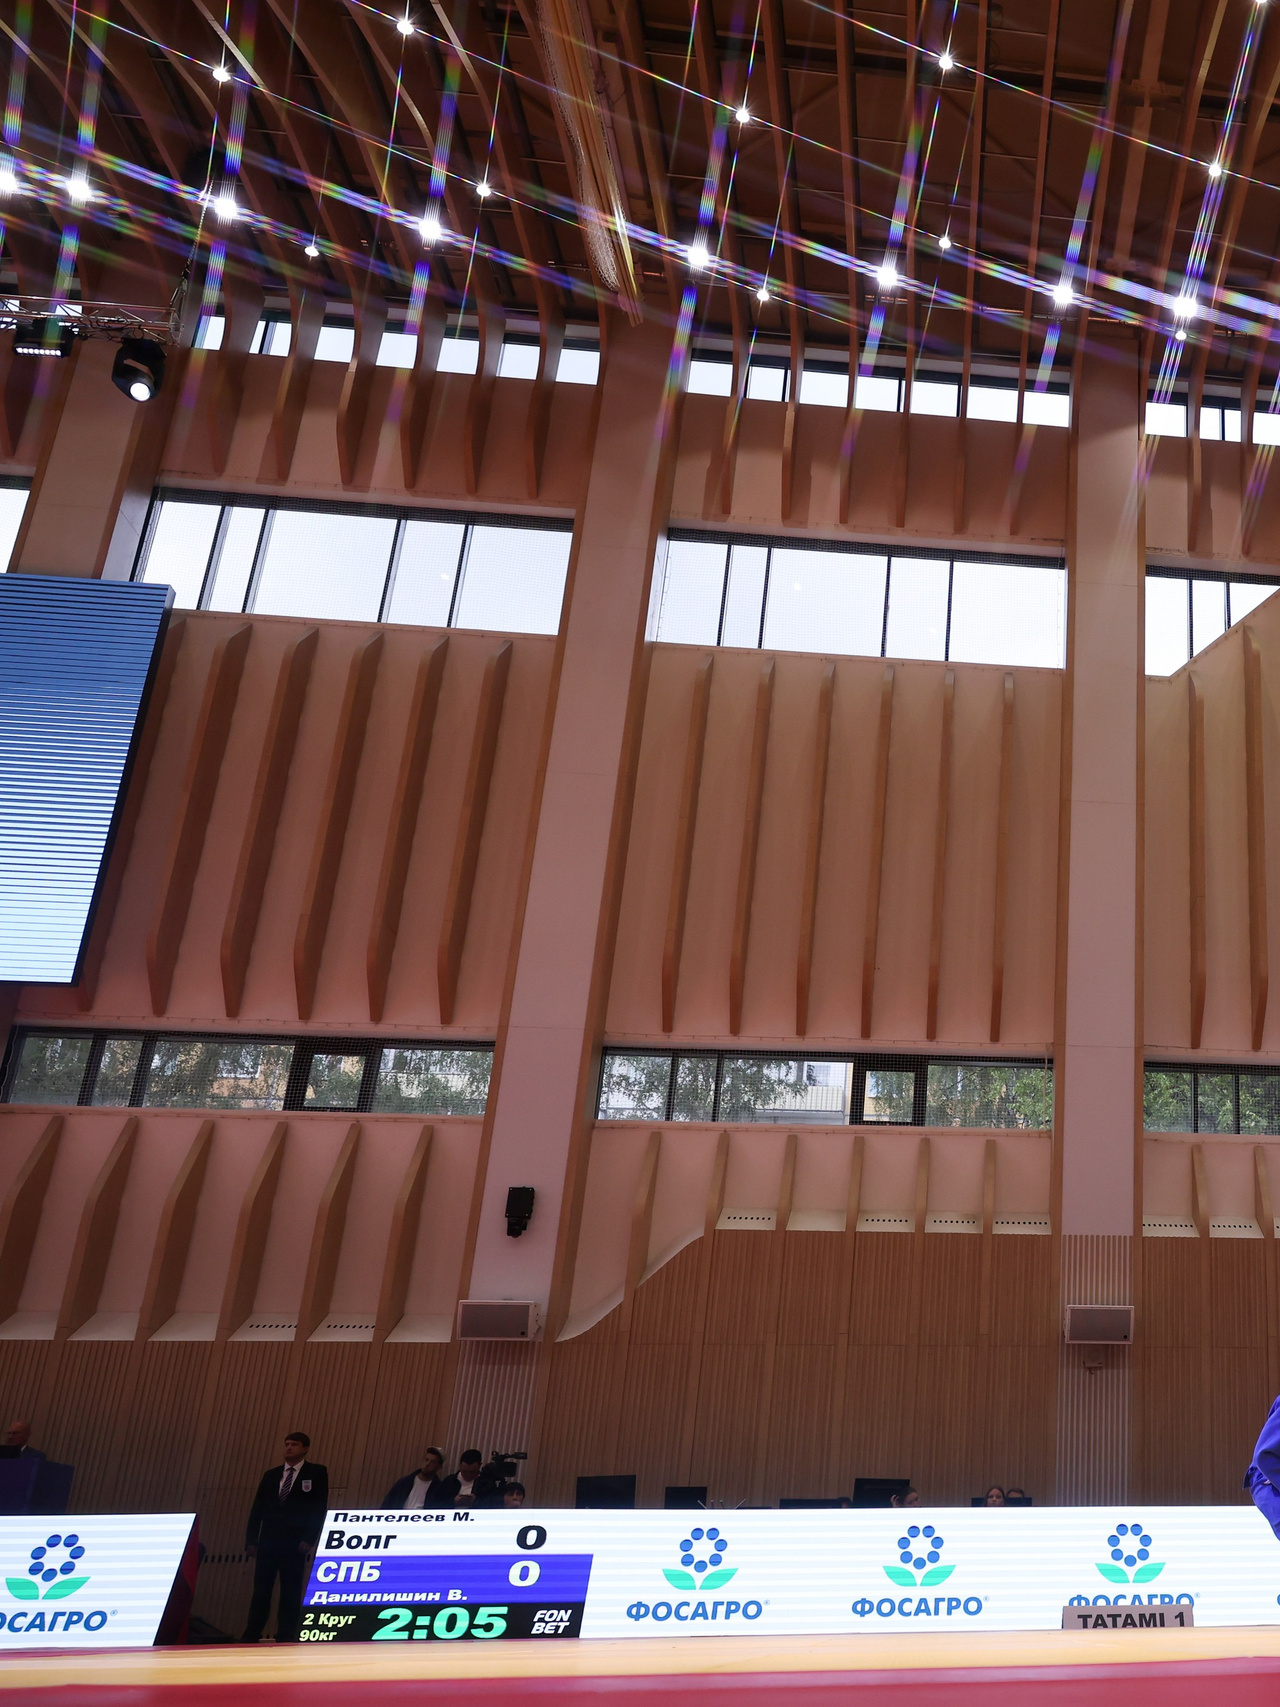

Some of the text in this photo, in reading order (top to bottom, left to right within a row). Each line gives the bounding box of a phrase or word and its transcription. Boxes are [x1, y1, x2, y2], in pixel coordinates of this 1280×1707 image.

[333, 1512, 475, 1522] Пантелеев М.
[325, 1530, 397, 1550] Волг
[516, 1525, 547, 1550] 0
[316, 1561, 382, 1583] СПБ
[508, 1560, 541, 1587] 0
[310, 1589, 468, 1605] Данилишин В.
[851, 1596, 983, 1618] ФОСАГРО
[303, 1613, 356, 1627] 2 Круг
[533, 1609, 572, 1622] FON
[626, 1600, 763, 1621] ФОСАГРО
[1077, 1612, 1185, 1629] TATAMI 1
[0, 1610, 108, 1633] САГРО
[371, 1606, 509, 1640] 2:05
[531, 1622, 570, 1634] BET
[299, 1629, 337, 1641] 90кг
